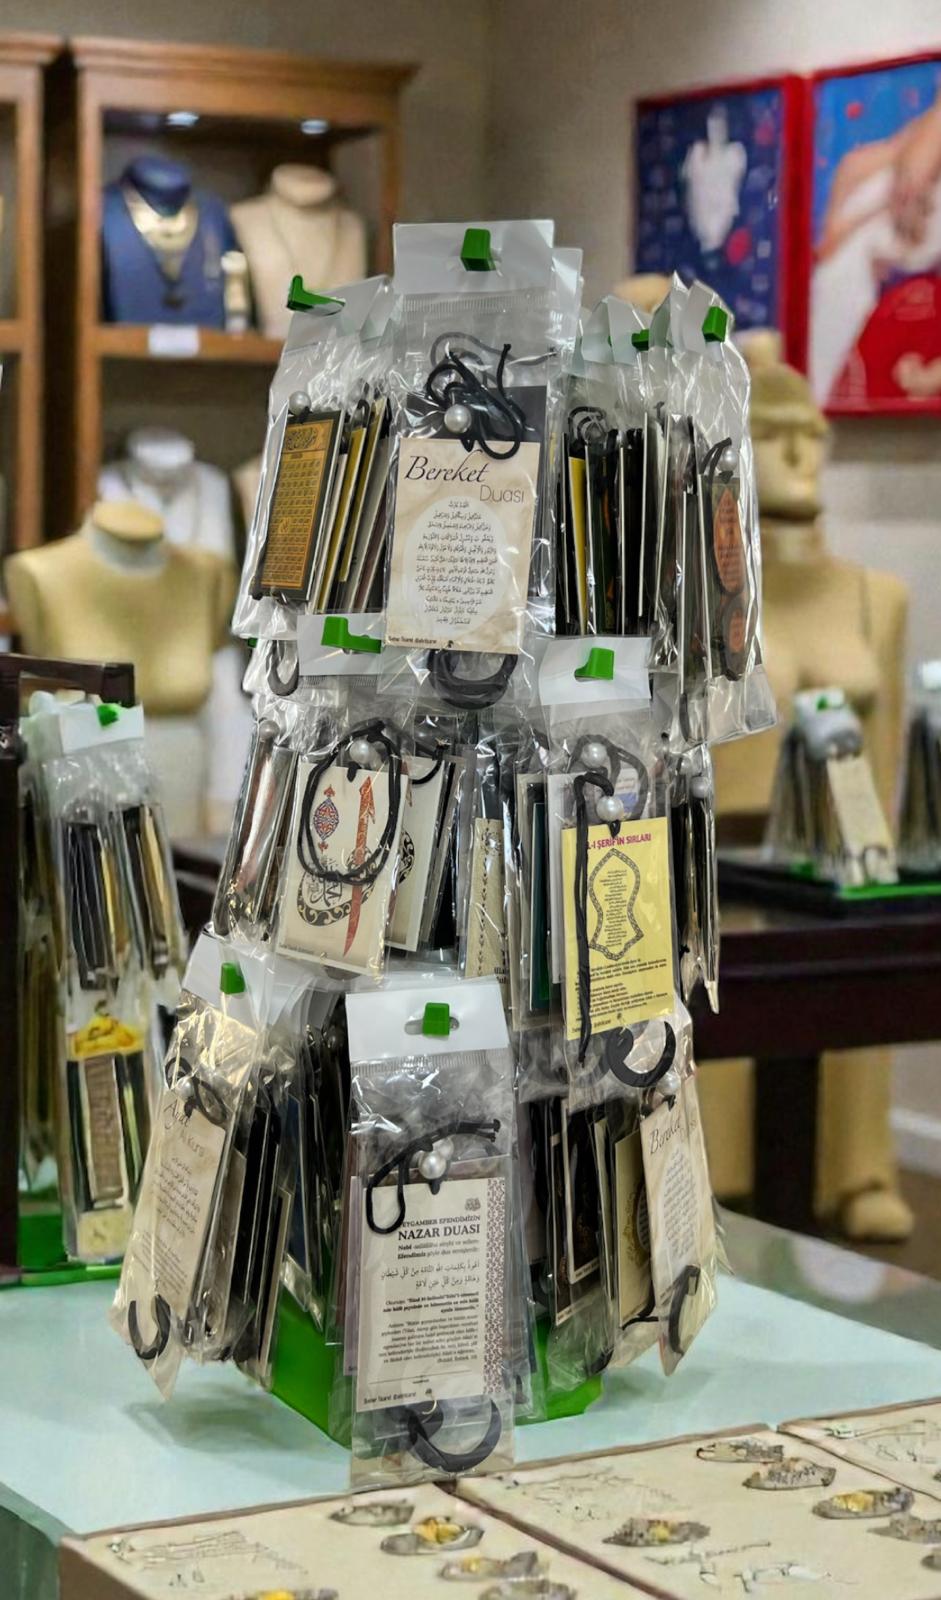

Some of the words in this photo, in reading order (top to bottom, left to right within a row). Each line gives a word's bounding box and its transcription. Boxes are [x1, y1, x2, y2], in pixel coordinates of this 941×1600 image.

[405, 448, 490, 483] Bereket
[479, 484, 525, 503] Duası
[626, 833, 652, 845] SIRLARI
[398, 1227, 440, 1241] NAZAR
[443, 1223, 480, 1237] DUASI
[401, 1219, 438, 1228] EYGAMBER
